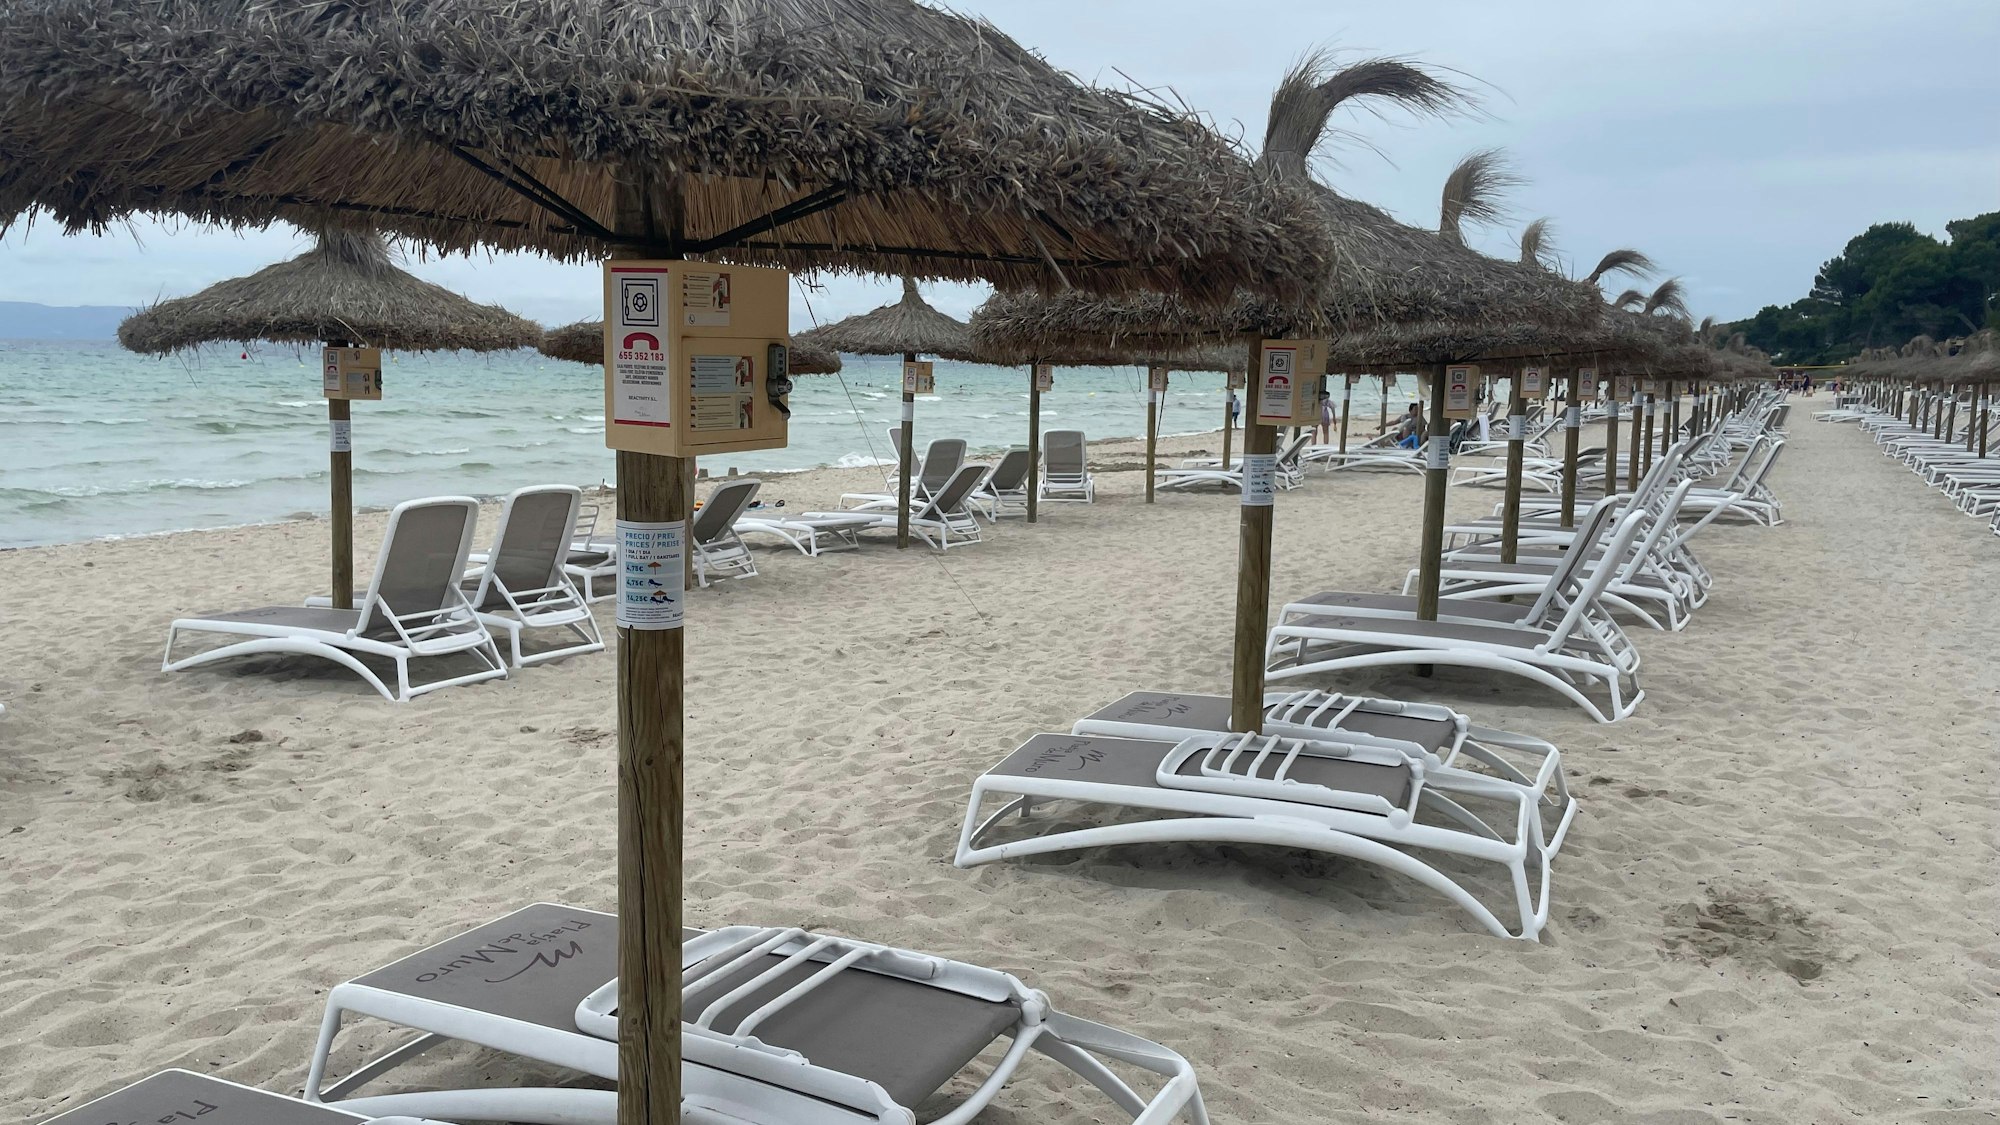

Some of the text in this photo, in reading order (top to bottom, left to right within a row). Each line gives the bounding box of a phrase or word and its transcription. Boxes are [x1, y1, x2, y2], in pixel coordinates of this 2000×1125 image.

[618, 351, 665, 361] 655 352 183
[625, 532, 650, 540] PRECIO
[657, 532, 676, 540] PREU
[625, 540, 650, 548] PRICES
[657, 540, 680, 548] PREISE
[415, 920, 592, 983] Platja de Muro
